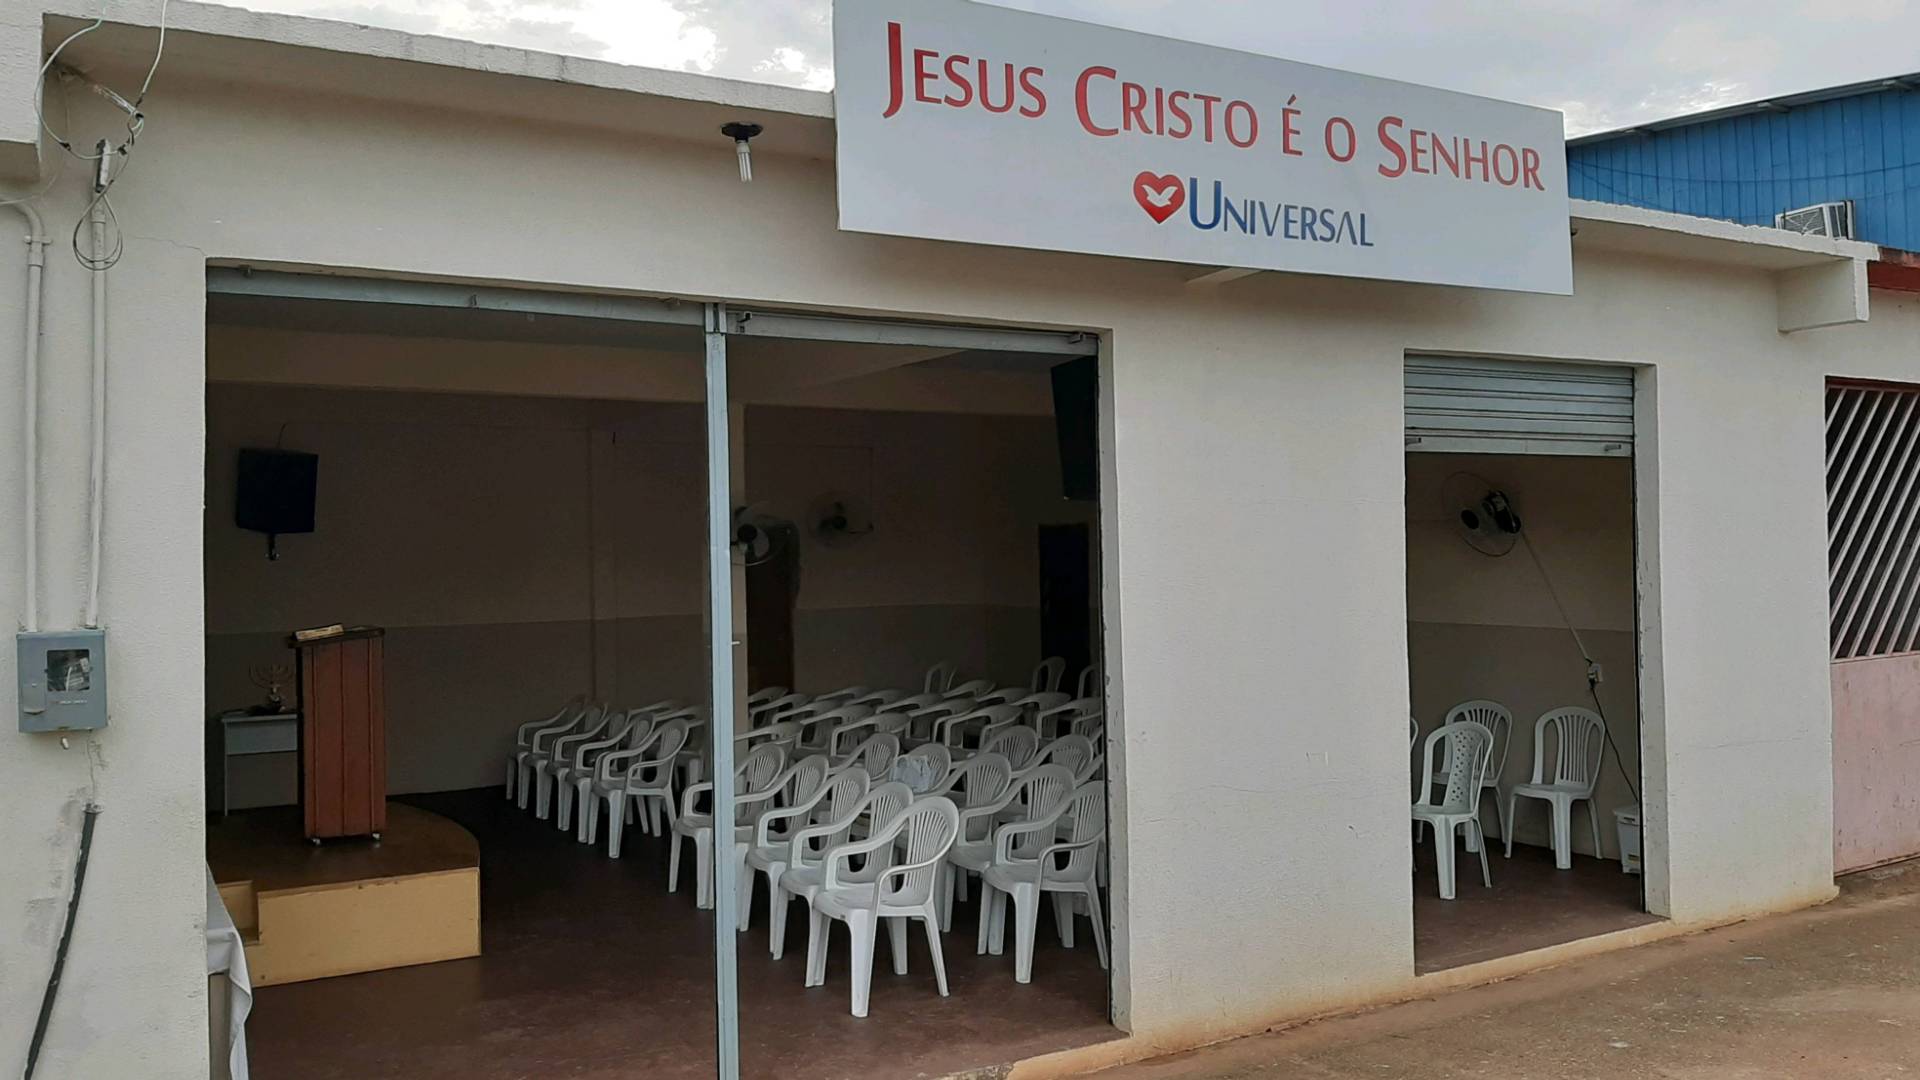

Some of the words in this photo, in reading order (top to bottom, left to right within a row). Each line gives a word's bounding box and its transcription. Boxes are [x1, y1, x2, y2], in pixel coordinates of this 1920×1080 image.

[882, 21, 1048, 120] JESUS
[1075, 65, 1259, 148] CRISTO
[1281, 94, 1303, 156] É
[1325, 116, 1357, 163] O
[1378, 115, 1546, 191] SENHOR
[1189, 177, 1375, 248] UNIVERSAL
